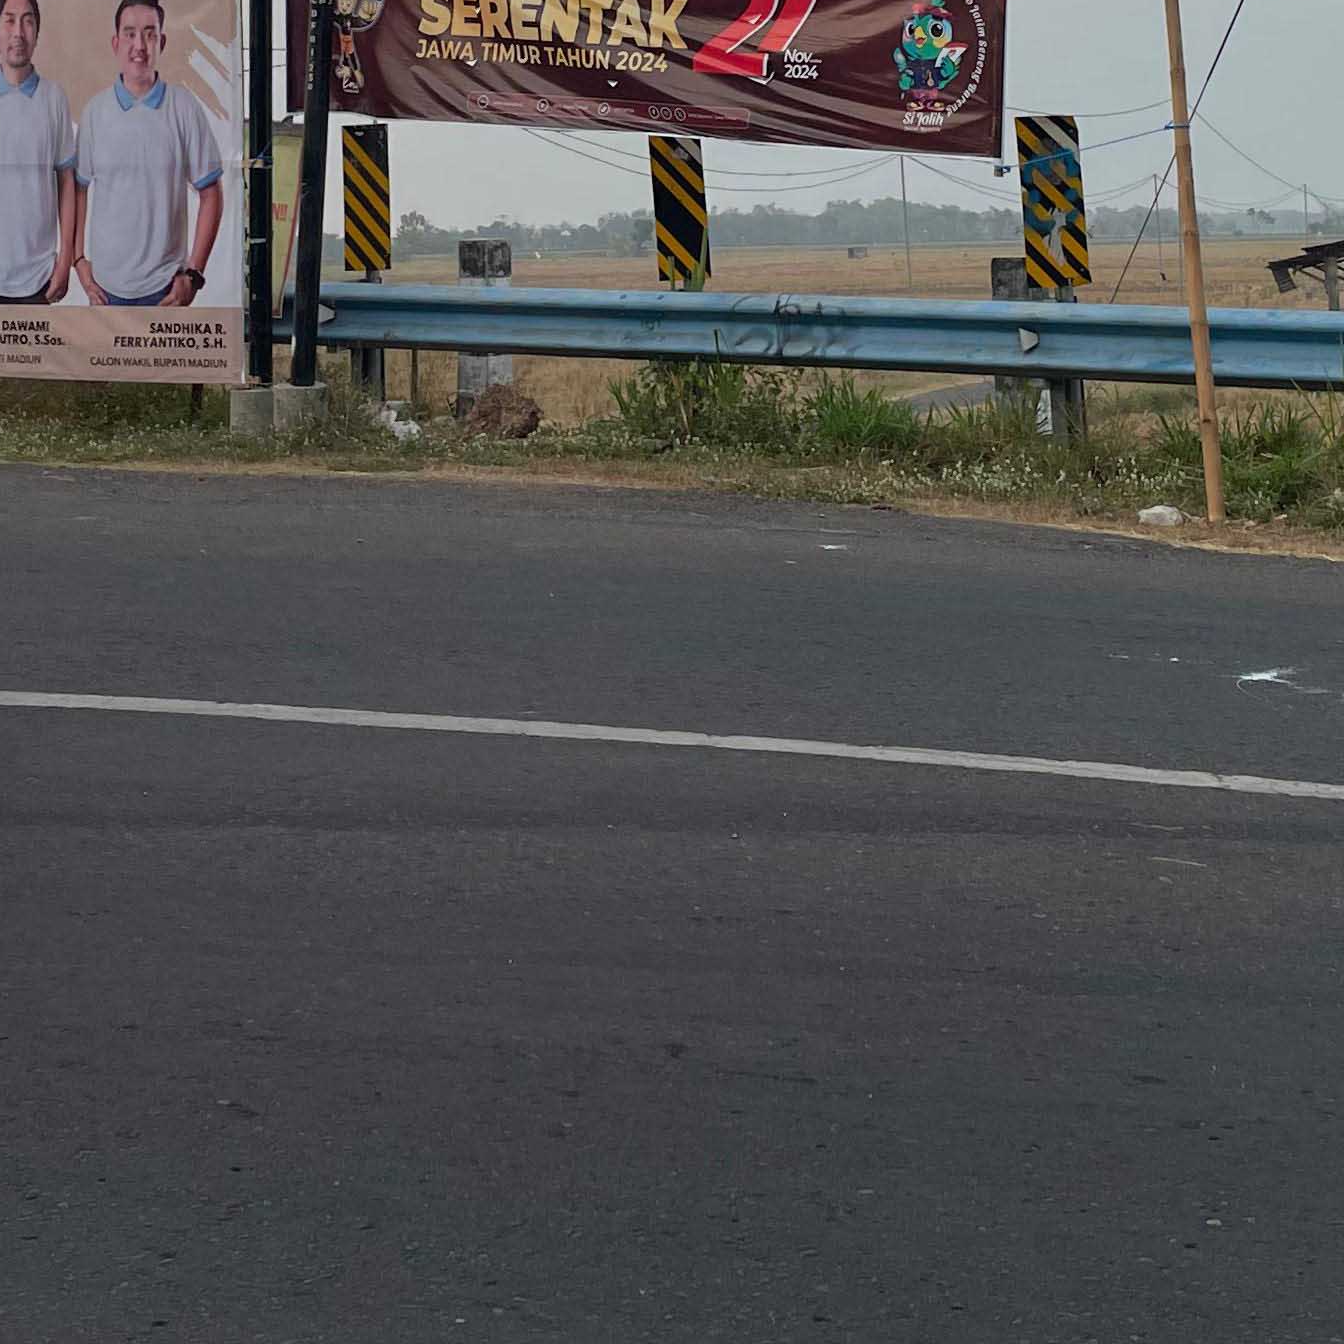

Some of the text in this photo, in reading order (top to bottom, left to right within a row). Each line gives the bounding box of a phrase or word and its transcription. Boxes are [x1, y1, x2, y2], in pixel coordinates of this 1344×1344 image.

[416, 38, 669, 74] JAWA TIMUR TAHUN 2024
[784, 63, 819, 80] 2024
[2, 320, 50, 332] DAWAMI
[150, 322, 227, 335] SANDHIKA R.
[113, 336, 227, 349] FERRYANTIKO, S.H.
[90, 356, 121, 367] CALON
[154, 358, 187, 368] BUPATI
[188, 358, 227, 369] MADIUN
